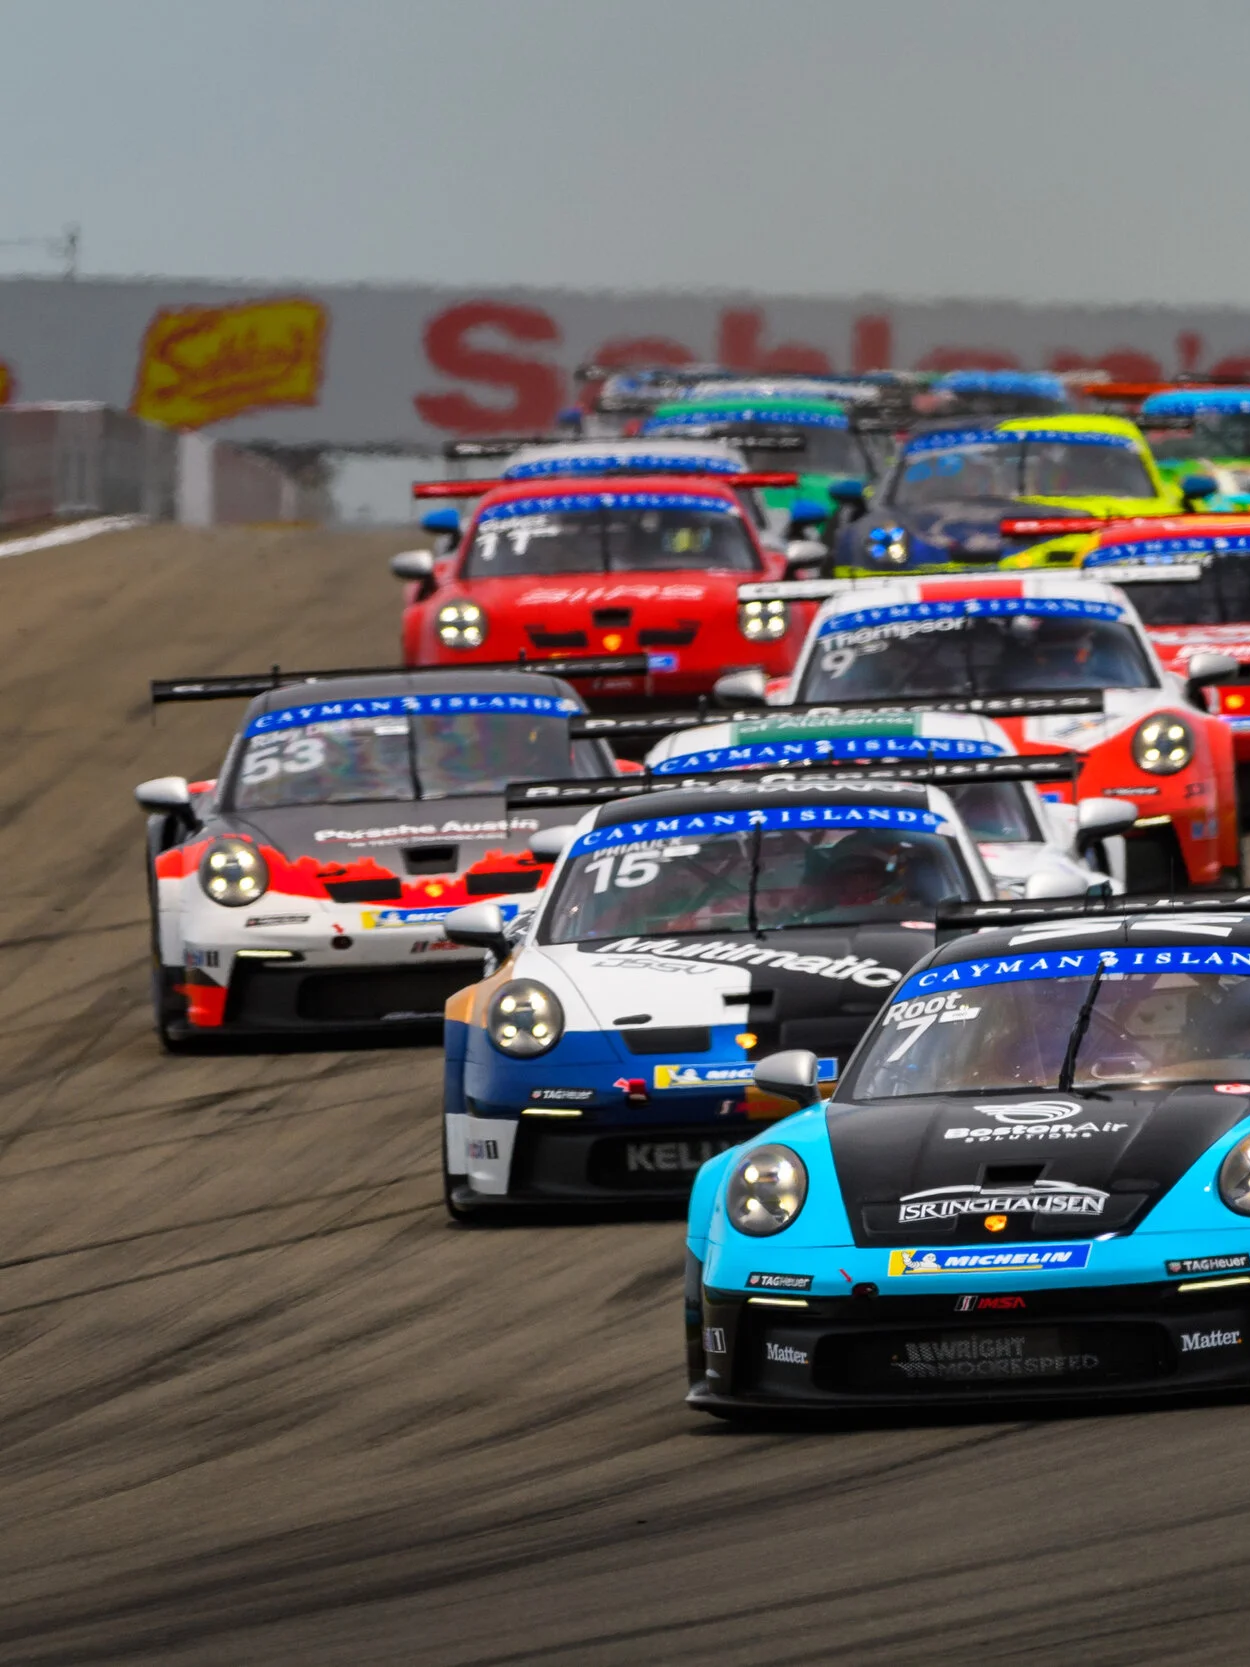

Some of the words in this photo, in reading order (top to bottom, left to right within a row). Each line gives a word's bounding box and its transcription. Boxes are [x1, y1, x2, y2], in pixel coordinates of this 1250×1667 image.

[821, 649, 856, 680] 9
[255, 700, 392, 729] CAYMAN
[242, 738, 326, 784] 53
[659, 743, 804, 773] CAYMAN
[847, 739, 1000, 756] ISLANDS
[314, 824, 437, 843] Porsche
[440, 817, 540, 834] Austin
[583, 813, 736, 846] CAYMAN
[781, 808, 937, 826] ISLANDS
[585, 850, 660, 893] 15
[595, 937, 903, 988] Multimatic
[918, 954, 1085, 989] CAYMAN
[882, 991, 965, 1026] Root
[886, 1013, 938, 1063] 7
[964, 1132, 1093, 1144] SOLUTIONS
[899, 1195, 1106, 1223] ISRINGHAUSEN
[943, 1250, 1073, 1268] MICHELIN
[977, 1295, 1027, 1310] IMSA
